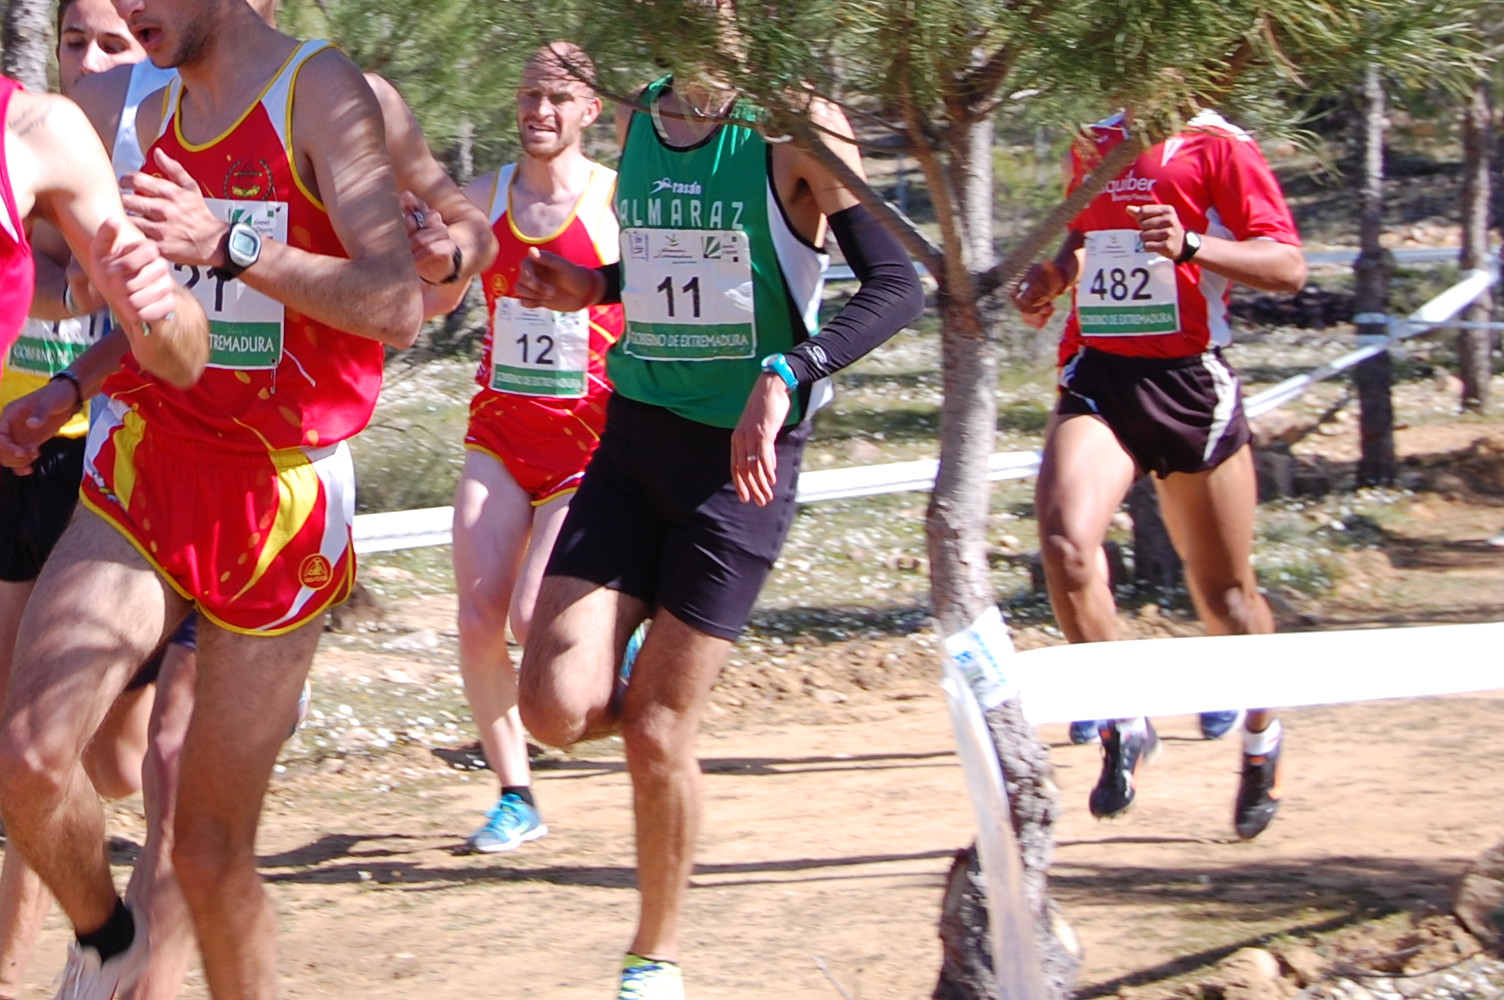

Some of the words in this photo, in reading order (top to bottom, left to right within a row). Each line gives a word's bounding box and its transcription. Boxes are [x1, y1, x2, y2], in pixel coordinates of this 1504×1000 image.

[619, 198, 744, 230] ALMARAZ
[657, 276, 701, 318] 11
[1089, 267, 1153, 301] 482
[208, 332, 275, 353] TREMADURA
[516, 333, 555, 365] 12
[680, 333, 750, 348] EXTREMADURA
